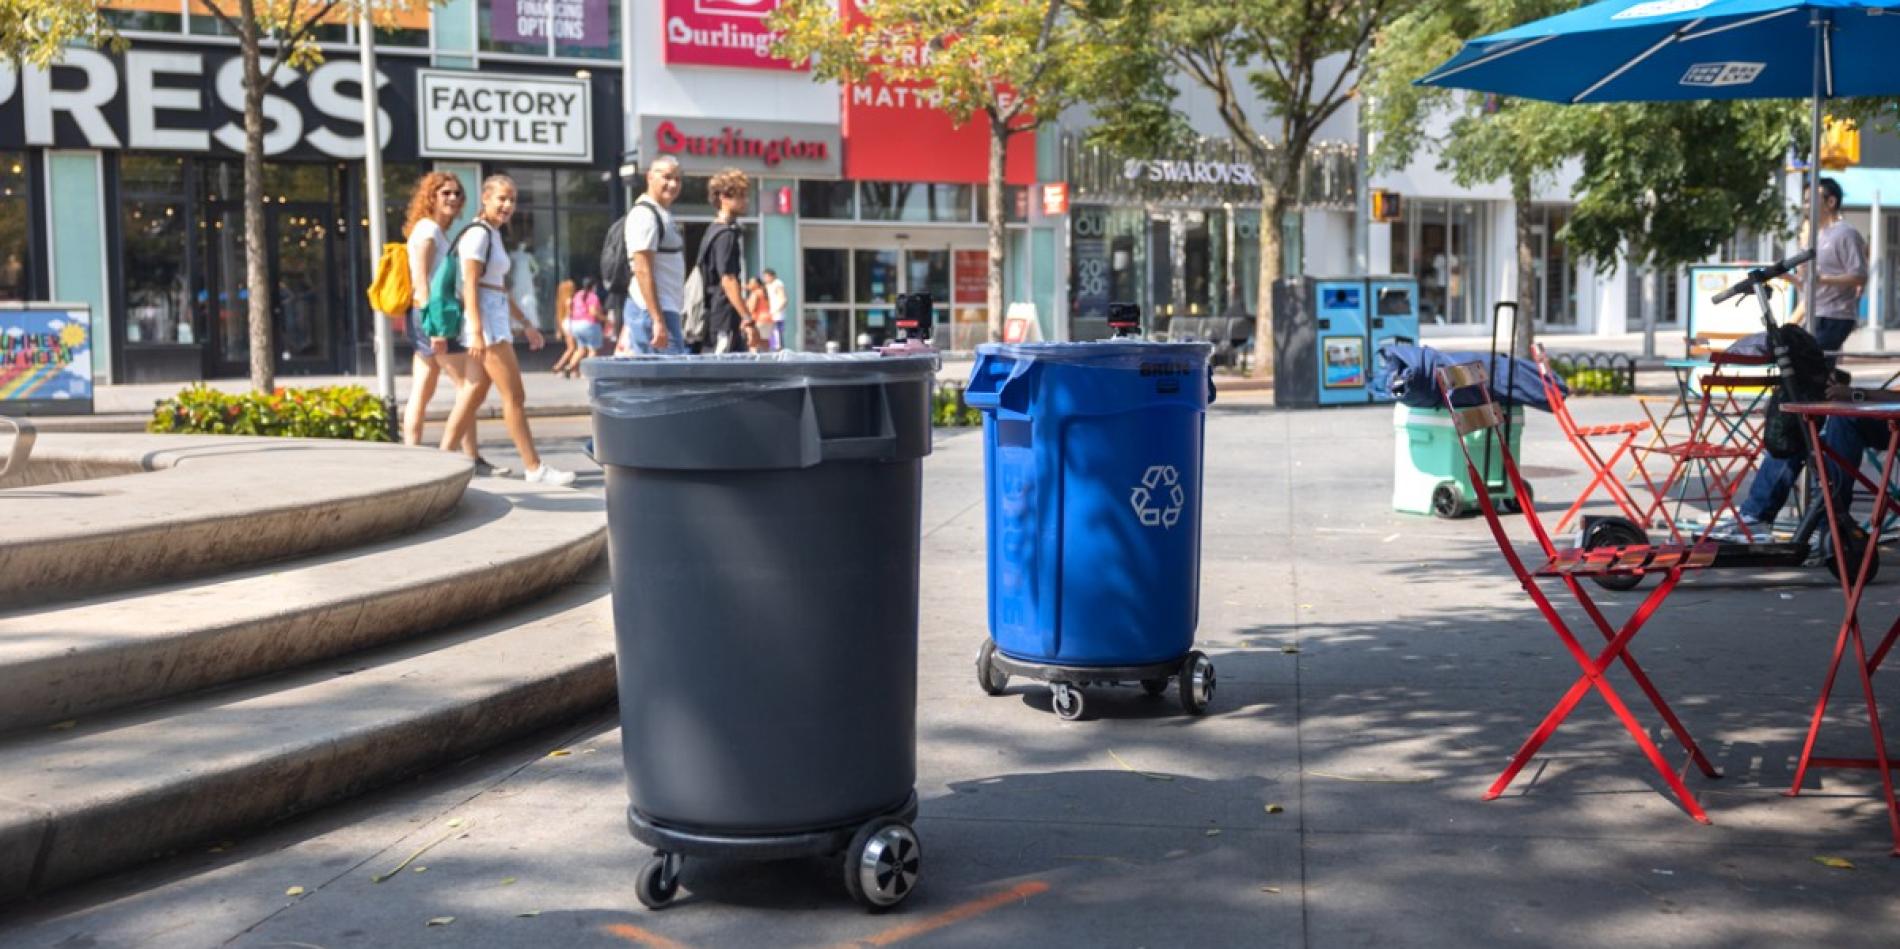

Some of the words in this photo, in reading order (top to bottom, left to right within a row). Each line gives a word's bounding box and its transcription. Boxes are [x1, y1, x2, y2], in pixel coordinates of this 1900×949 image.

[517, 16, 584, 40] OPTIONS
[0, 47, 392, 160] RESS
[431, 86, 576, 115] FACTORY
[445, 116, 568, 144] OUTLET
[656, 120, 828, 168] Burlington
[1149, 159, 1258, 185] SWAROVSK
